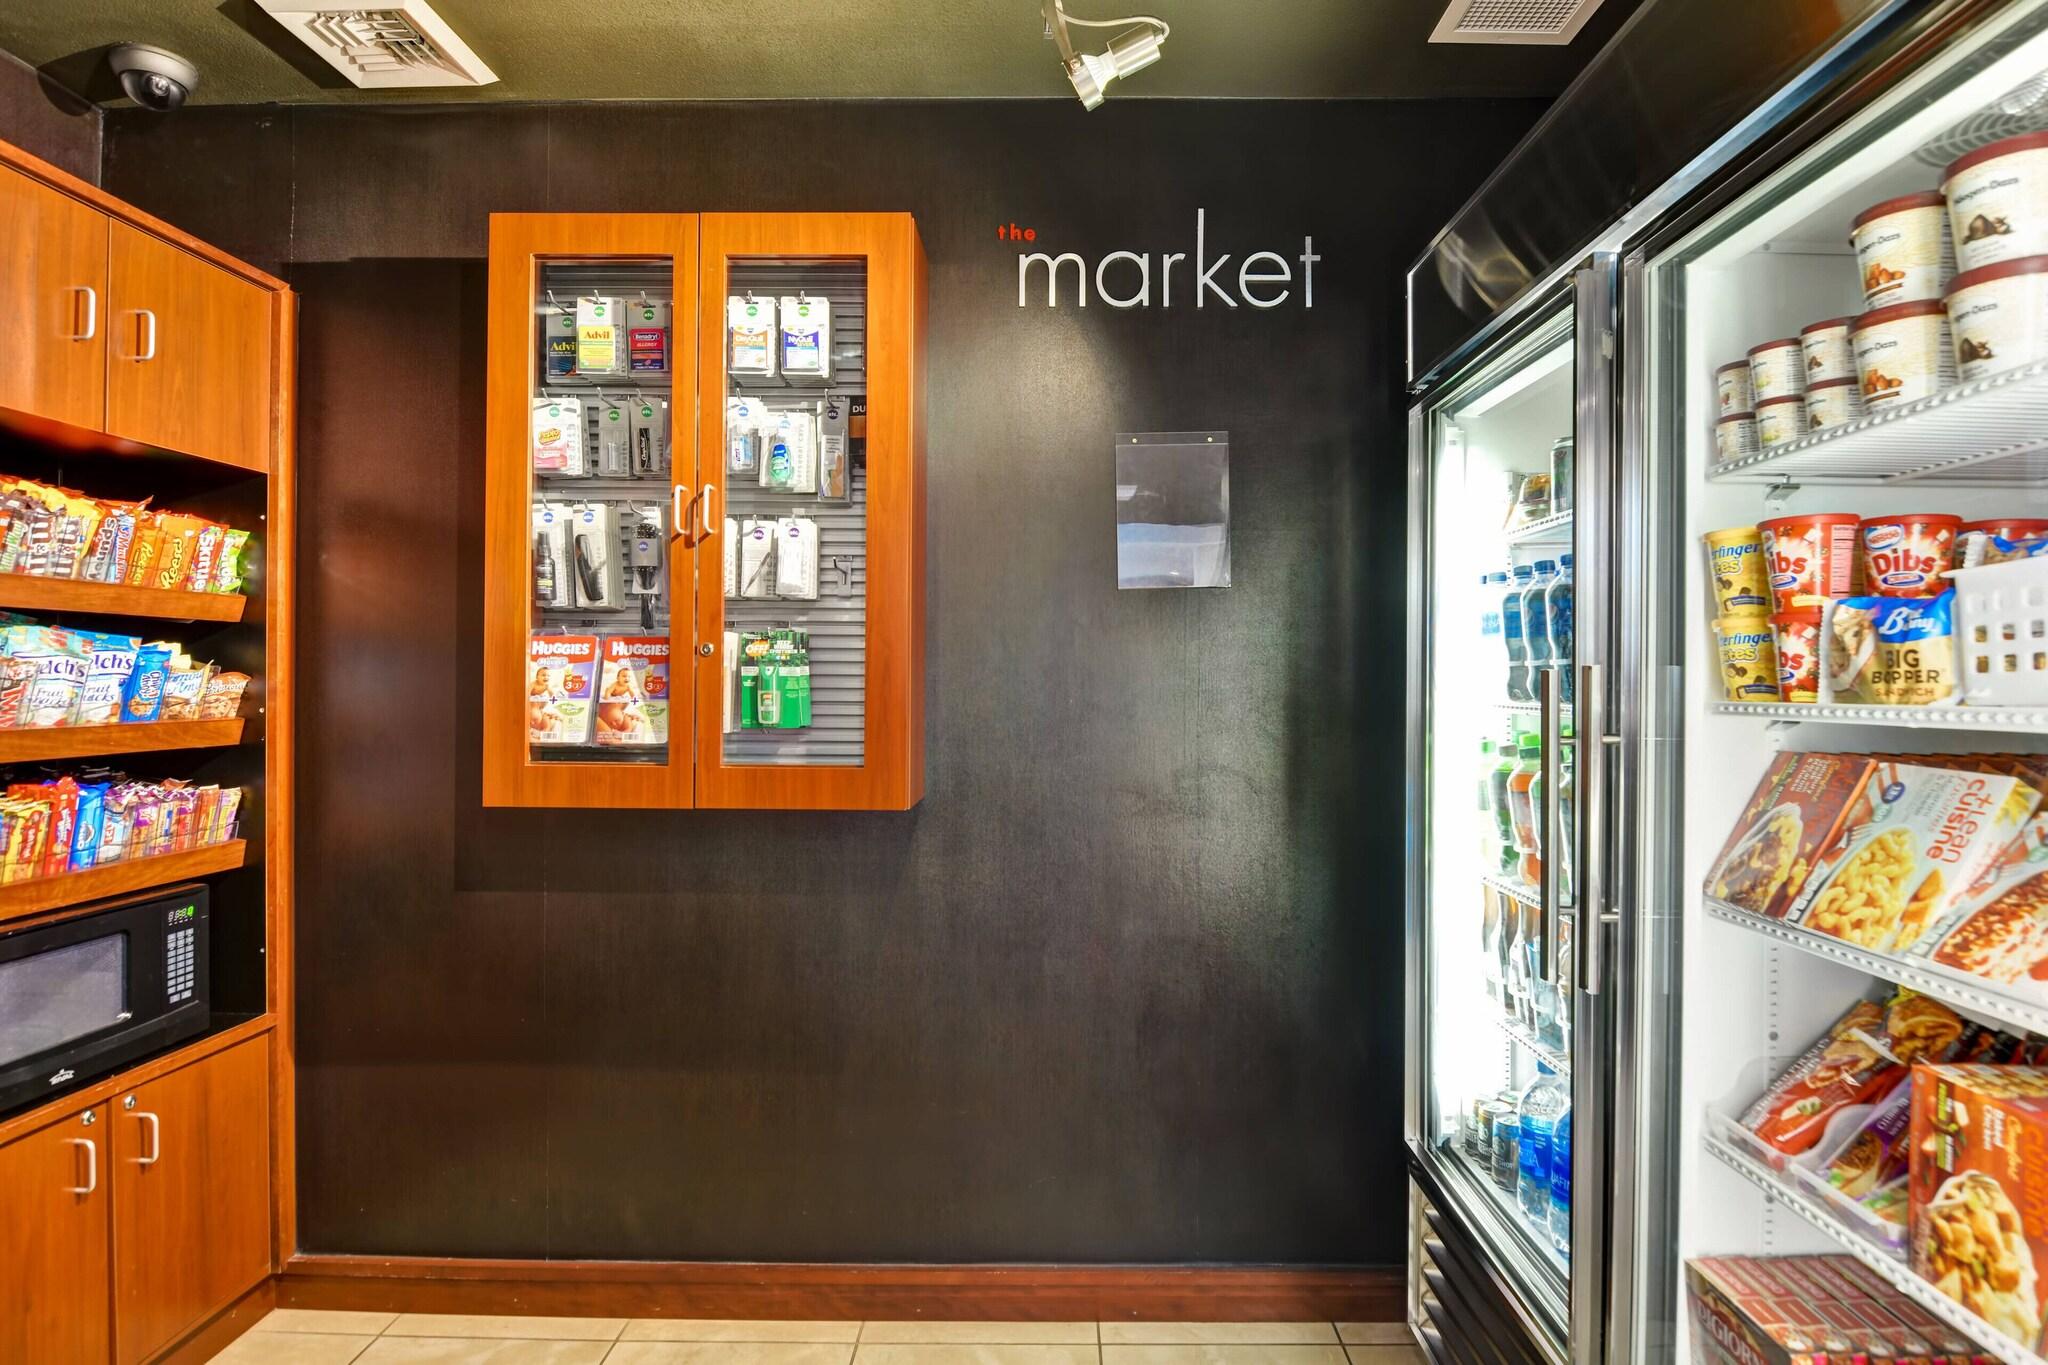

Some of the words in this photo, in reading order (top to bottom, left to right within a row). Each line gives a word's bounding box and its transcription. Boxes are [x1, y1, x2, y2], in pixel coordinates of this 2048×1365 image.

[997, 223, 1036, 241] the
[1018, 208, 1321, 307] market
[584, 331, 610, 340] Advil
[551, 341, 577, 352] Advi
[194, 533, 217, 592] Skittle
[1871, 548, 1938, 576] Dibs
[531, 641, 591, 655] HUGGIES
[611, 642, 670, 656] HUGGIES
[1885, 648, 1920, 669] BIG
